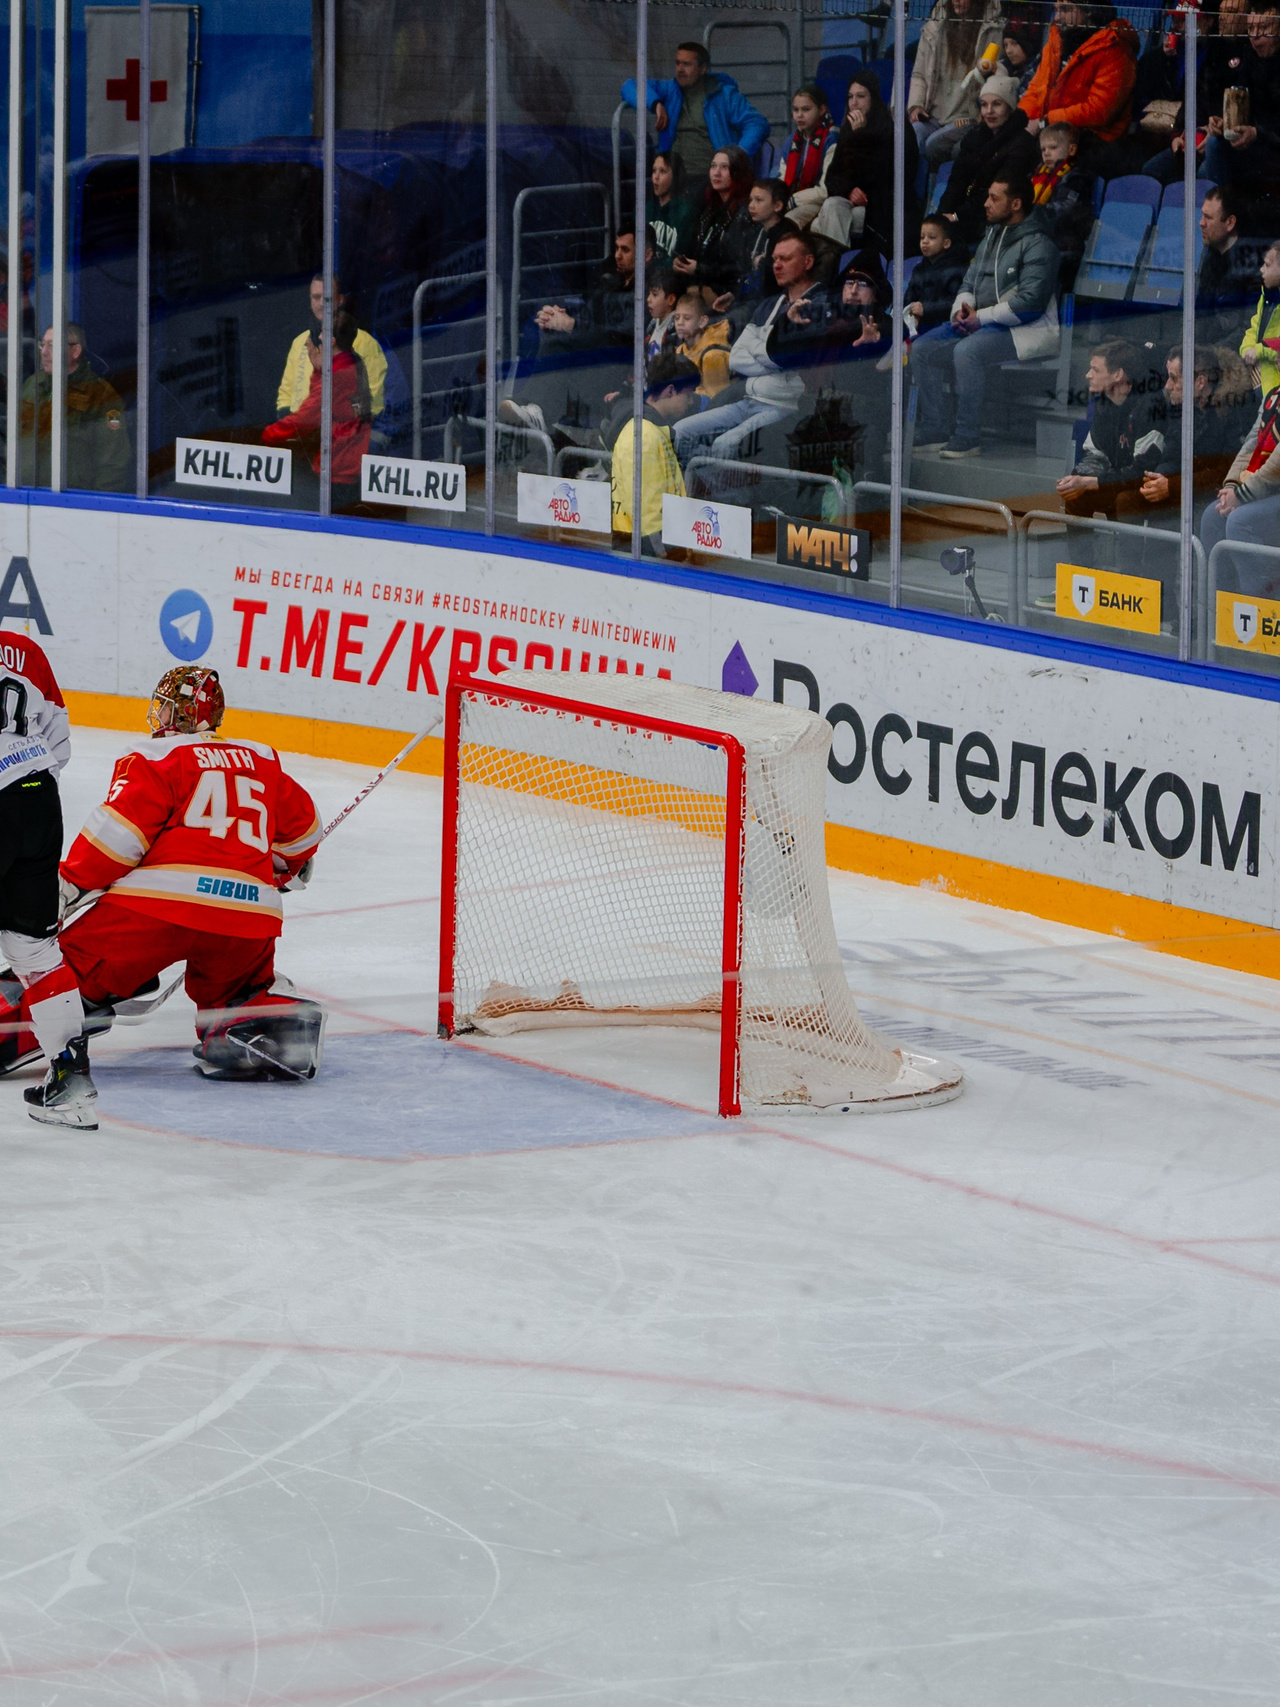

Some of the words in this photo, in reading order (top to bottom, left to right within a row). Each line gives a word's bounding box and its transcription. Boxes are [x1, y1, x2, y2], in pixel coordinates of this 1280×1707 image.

[183, 447, 284, 484] KHL.RU
[368, 463, 459, 502] KHL.RU
[548, 498, 569, 510] АВТО
[554, 509, 581, 524] РАДИО
[691, 521, 712, 535] АВТО
[697, 533, 722, 549] РАДИО
[787, 522, 858, 573] МАТЧ!
[234, 566, 262, 584] МЫ
[271, 570, 334, 594] ВСЕГДА
[343, 578, 363, 598] НА
[372, 583, 425, 606] СВЯЗИ
[432, 592, 566, 630] #REDSTARHOCKEY
[572, 616, 678, 653] #UNITEDWEWIN
[1098, 589, 1144, 614] БАНК
[192, 746, 256, 771] SMITH
[183, 769, 270, 855] 45
[195, 875, 260, 903] SIBUR
